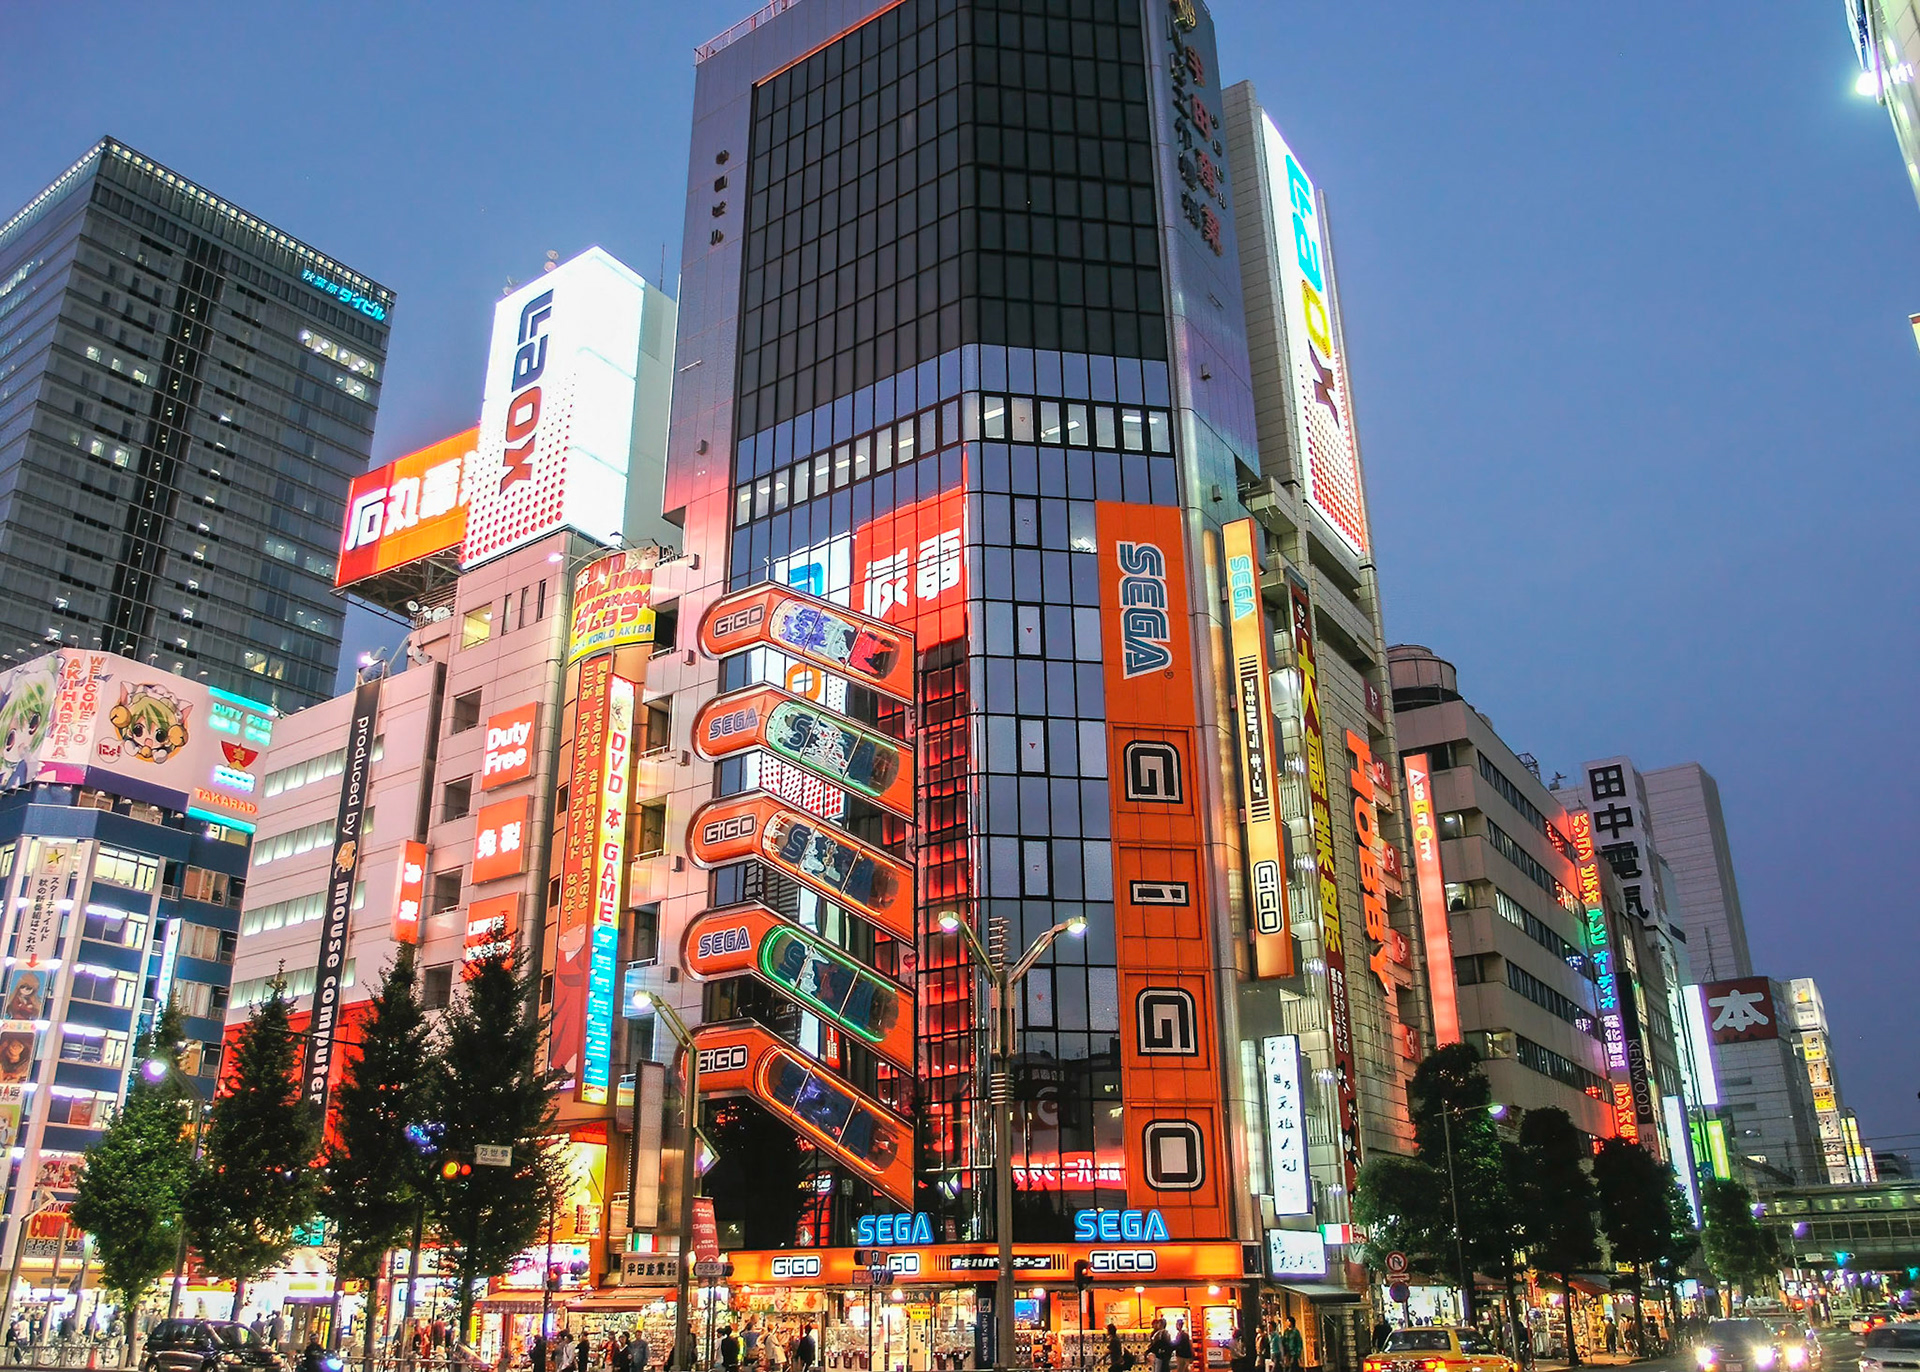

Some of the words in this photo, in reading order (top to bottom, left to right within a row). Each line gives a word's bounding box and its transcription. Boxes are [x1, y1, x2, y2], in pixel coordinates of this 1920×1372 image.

[302, 269, 386, 321] 秋葉原ダイビル
[1228, 555, 1256, 620] SEGA
[619, 623, 652, 636] AKIBA
[1115, 540, 1173, 680] SEGA
[51, 659, 82, 758] AKIHABARA
[79, 656, 106, 720] WELCOME
[212, 702, 244, 719] DUTY
[709, 707, 758, 740] SEGA
[73, 725, 88, 743] TO
[487, 718, 532, 750] Duty
[349, 715, 370, 807] produced
[484, 744, 528, 776] Free
[608, 732, 627, 794] DVD
[344, 811, 359, 838] by
[1573, 814, 1593, 861] パソコン
[599, 843, 619, 923] GAME
[1346, 729, 1389, 996] HOBBY
[1580, 864, 1600, 903] ビデオ
[40, 877, 59, 942] スターチャイルド
[332, 880, 351, 947] mouse
[1587, 908, 1606, 945] テレビ
[698, 927, 751, 958] SEGA
[1593, 950, 1617, 1009] オーディオ
[309, 953, 342, 1105] computer
[1629, 1039, 1651, 1115] KENWOOD
[858, 1212, 934, 1246] SEGA
[1074, 1209, 1170, 1241] SEGA
[772, 1256, 820, 1277] GiGO
[951, 1257, 999, 1269] アキハバ
[1090, 1250, 1156, 1273] GiGO
